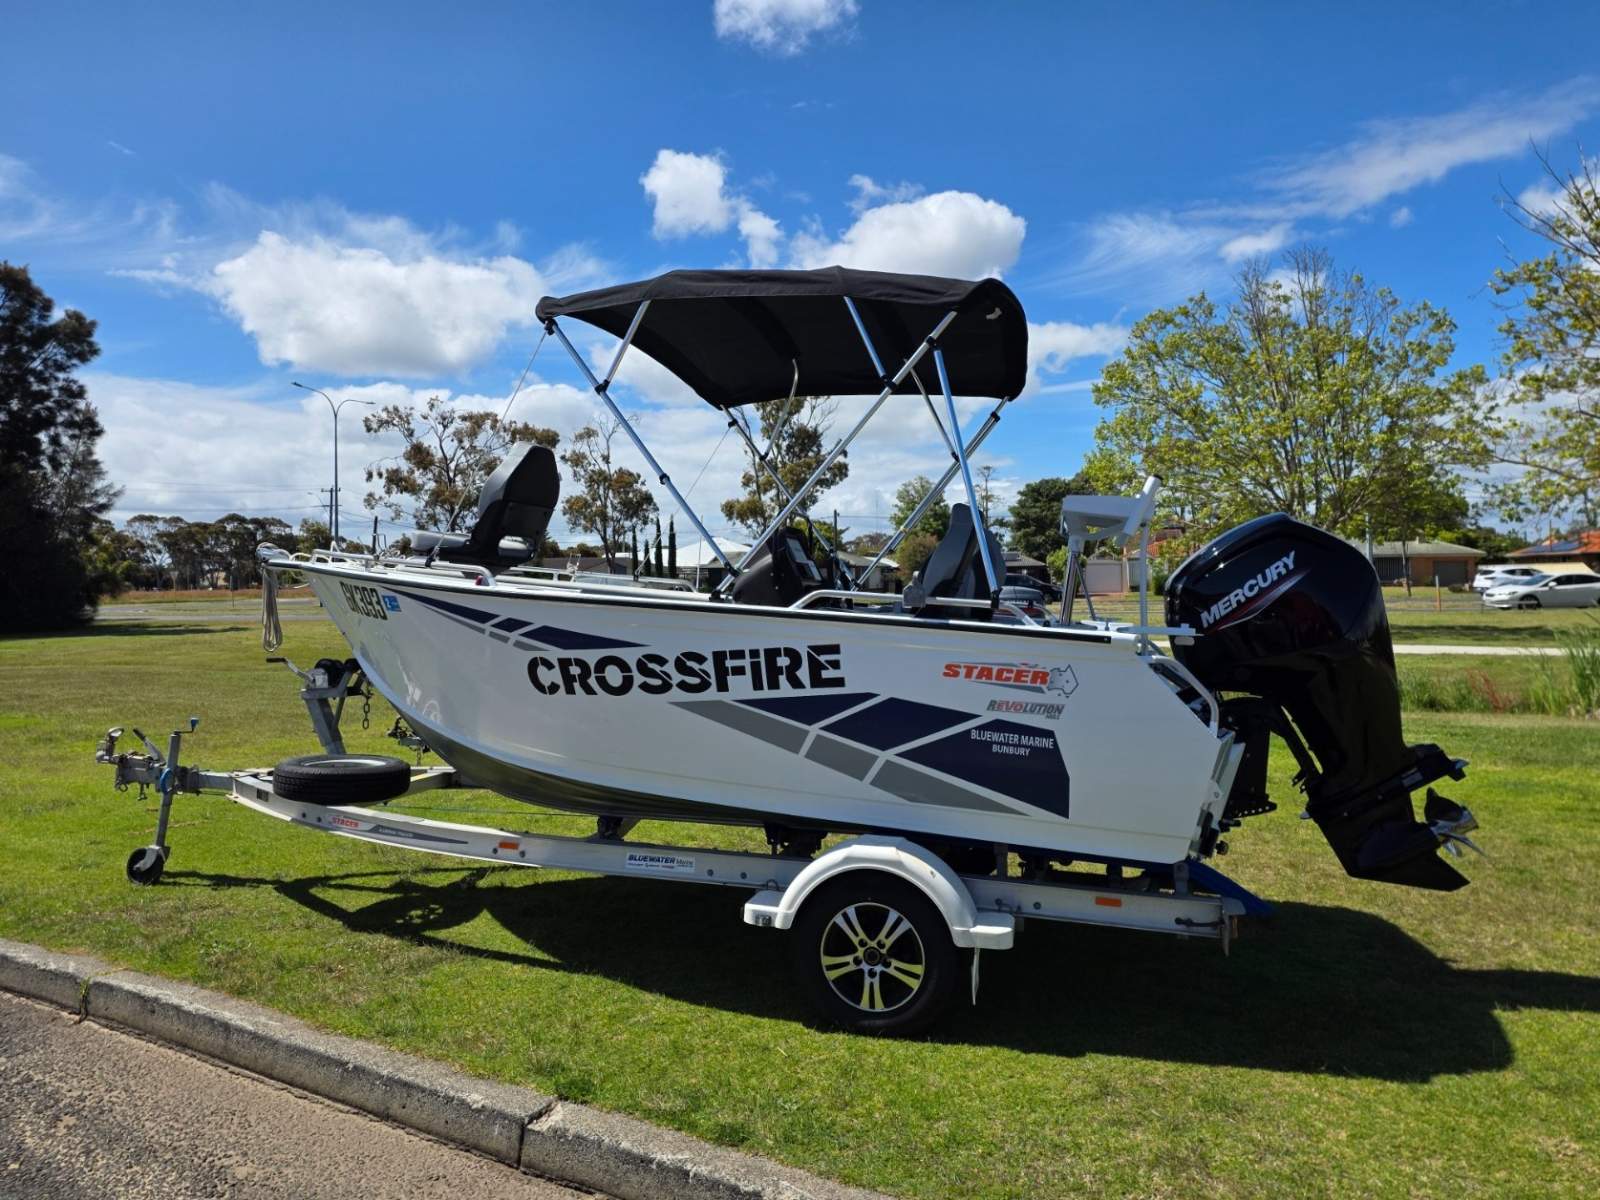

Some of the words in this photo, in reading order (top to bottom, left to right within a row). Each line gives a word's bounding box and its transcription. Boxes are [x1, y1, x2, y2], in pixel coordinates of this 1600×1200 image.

[1200, 550, 1296, 628] MERCURY
[943, 663, 1050, 686] STACER
[970, 729, 1019, 744] BLUEWATER
[1020, 735, 1054, 749] MARINE
[992, 744, 1030, 756] BUNBURY
[628, 854, 676, 865] BLUEWATER
